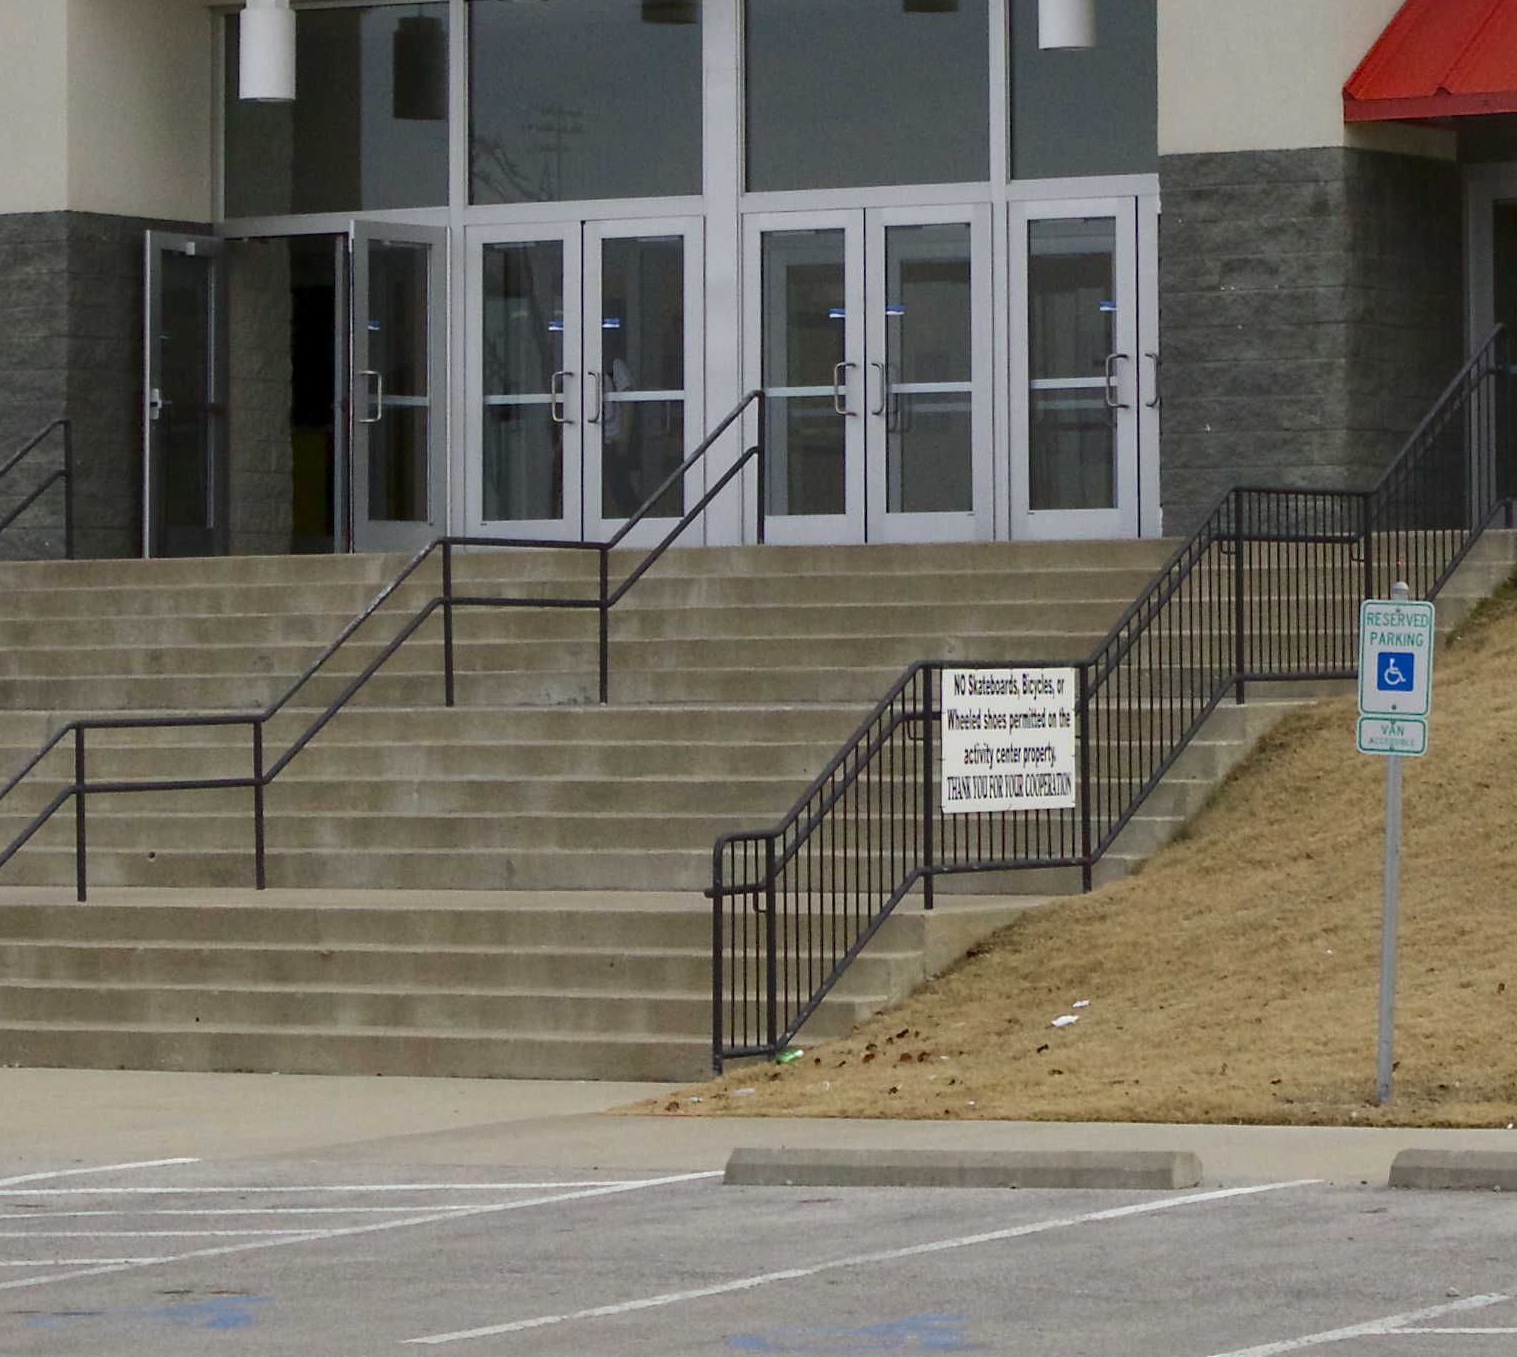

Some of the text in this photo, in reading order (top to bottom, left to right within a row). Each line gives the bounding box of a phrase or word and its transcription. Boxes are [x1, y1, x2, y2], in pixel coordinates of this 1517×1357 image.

[1366, 612, 1429, 628] RESERVED
[1370, 632, 1424, 647] PARKING
[954, 673, 1065, 700] NO Skateboards, Bicycles, or
[947, 707, 1071, 735] Wheeled shoes permitted on the
[1381, 724, 1404, 736] VAN
[964, 742, 994, 769] activity
[996, 743, 1021, 763] center
[947, 773, 1072, 800] THANK YOU FOR YOUR COOPERATION
